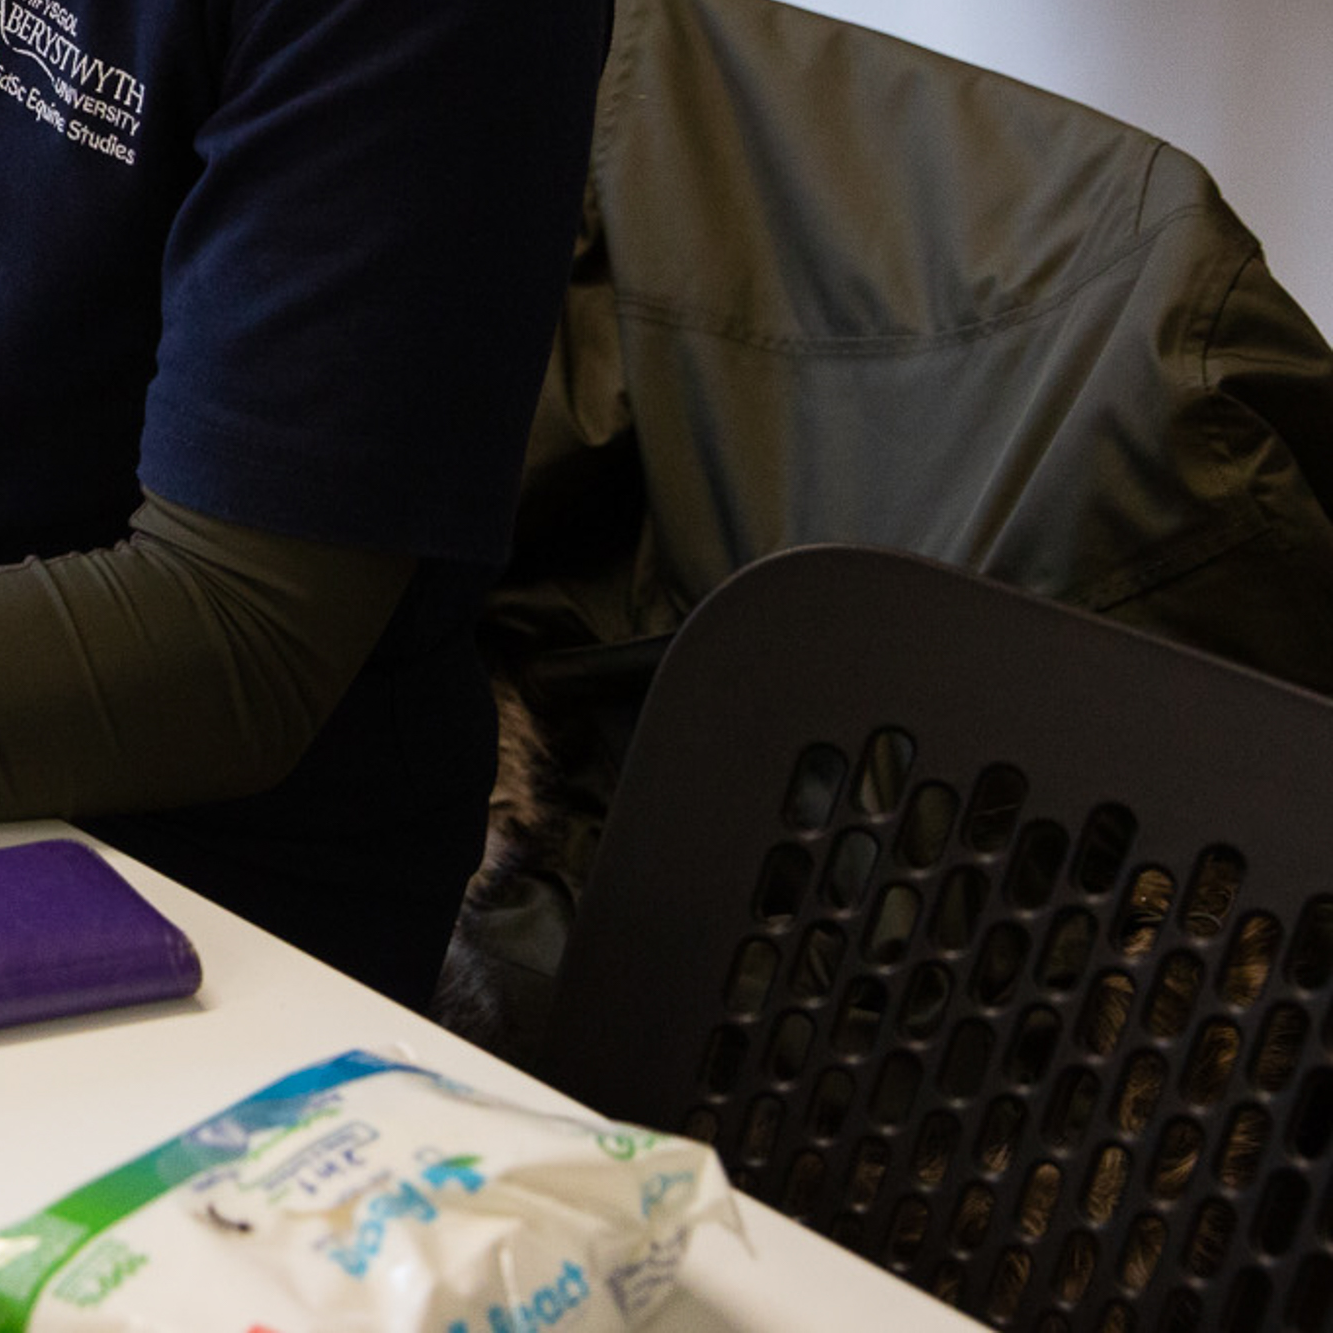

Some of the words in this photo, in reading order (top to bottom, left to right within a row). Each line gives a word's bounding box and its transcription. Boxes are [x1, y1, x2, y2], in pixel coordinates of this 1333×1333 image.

[25, 88, 66, 134] Equine
[67, 119, 137, 166] Studies
[52, 77, 141, 137] UNIVERSITY
